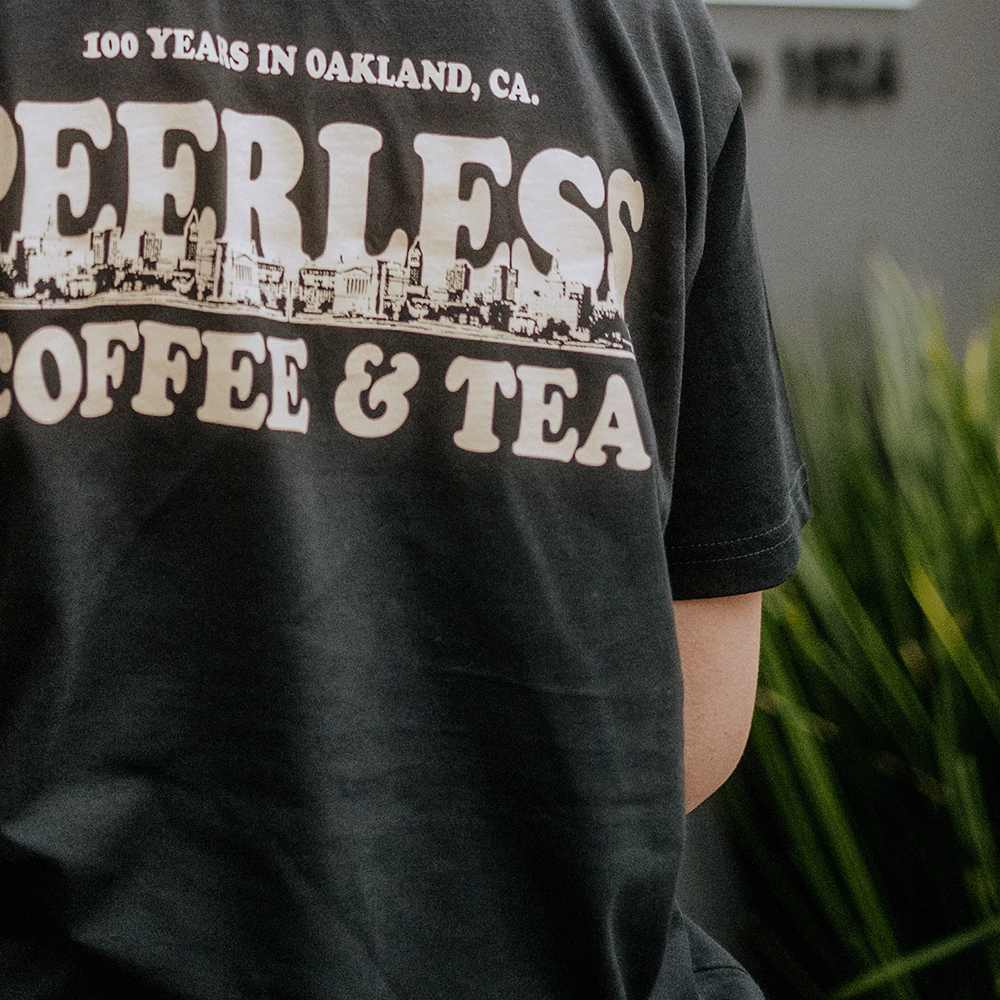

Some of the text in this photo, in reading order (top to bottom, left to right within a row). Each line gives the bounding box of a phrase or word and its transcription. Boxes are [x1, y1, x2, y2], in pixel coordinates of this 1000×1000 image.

[83, 27, 540, 106] 100 YEARS IN OAKLAND, CA.
[334, 342, 420, 438] &
[444, 355, 652, 471] TEA
